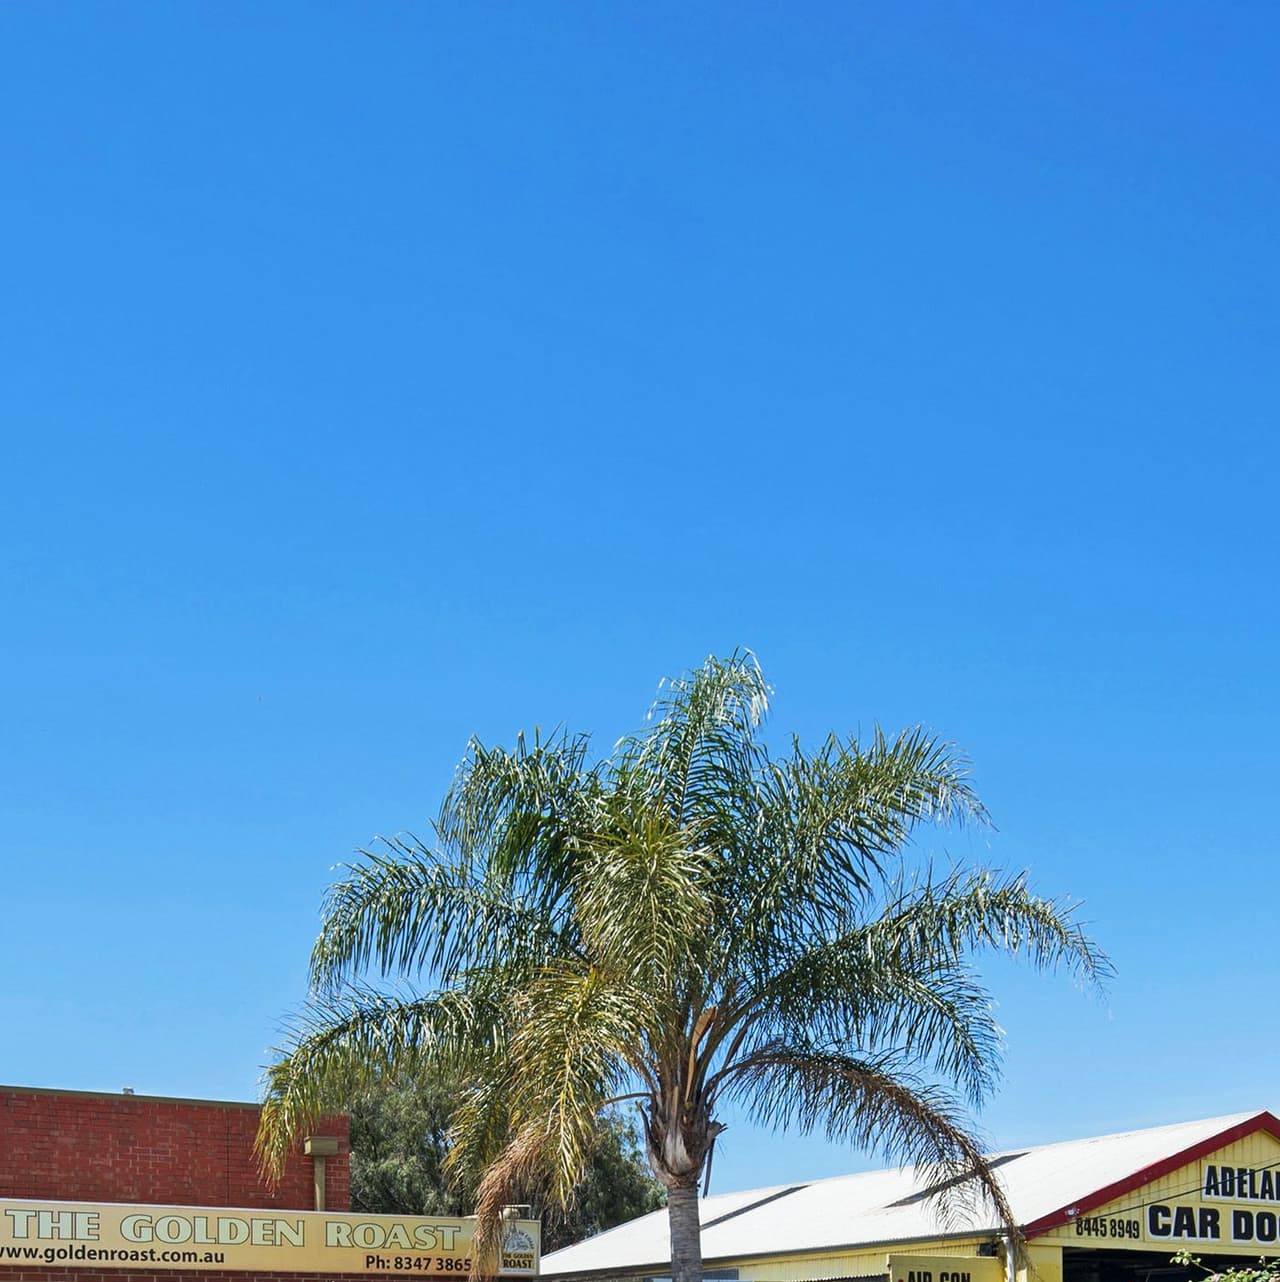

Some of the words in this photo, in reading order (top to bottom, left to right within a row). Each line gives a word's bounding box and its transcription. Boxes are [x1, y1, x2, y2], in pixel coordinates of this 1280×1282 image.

[5, 1209, 100, 1240] THE
[120, 1214, 305, 1247] GOLDEN
[325, 1221, 461, 1251] ROAST
[1076, 1216, 1107, 1238] 8445
[1110, 1218, 1140, 1239] 8949
[1148, 1205, 1220, 1240] CAR
[366, 1255, 390, 1270] Ph:
[394, 1256, 432, 1271] 8347
[436, 1257, 472, 1271] 3865
[503, 1259, 532, 1268] ROAST
